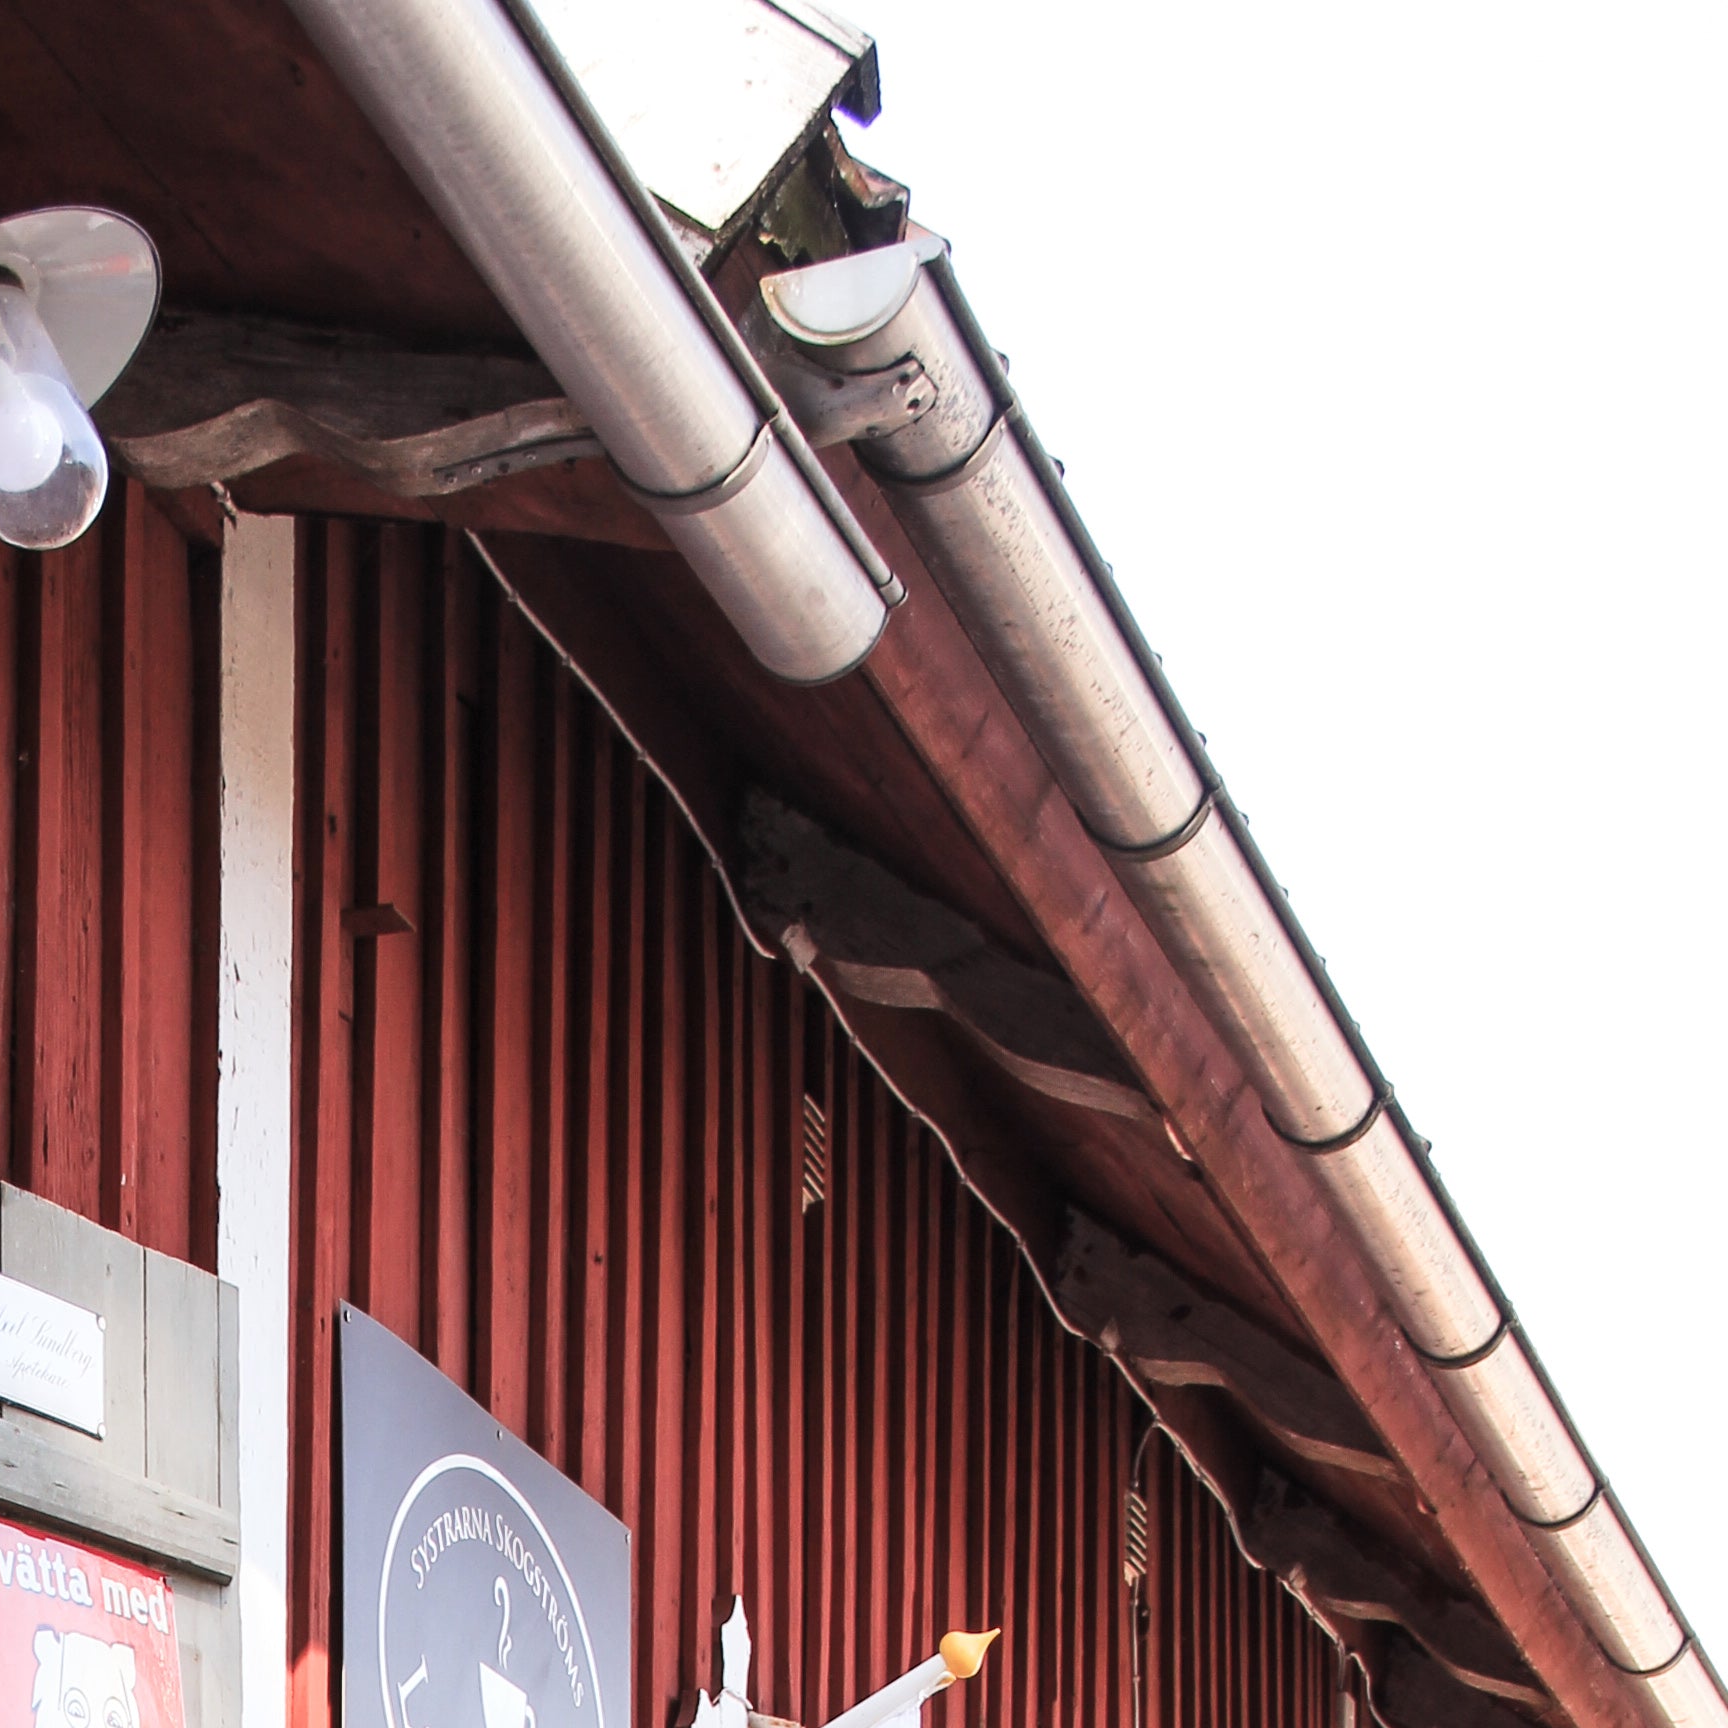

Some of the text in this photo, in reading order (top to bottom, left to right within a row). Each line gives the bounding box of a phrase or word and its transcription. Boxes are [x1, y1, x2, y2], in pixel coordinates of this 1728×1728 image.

[100, 1577, 169, 1634] med
[410, 1507, 585, 1708] SYSTRARNA SKOGSTRÖMS
